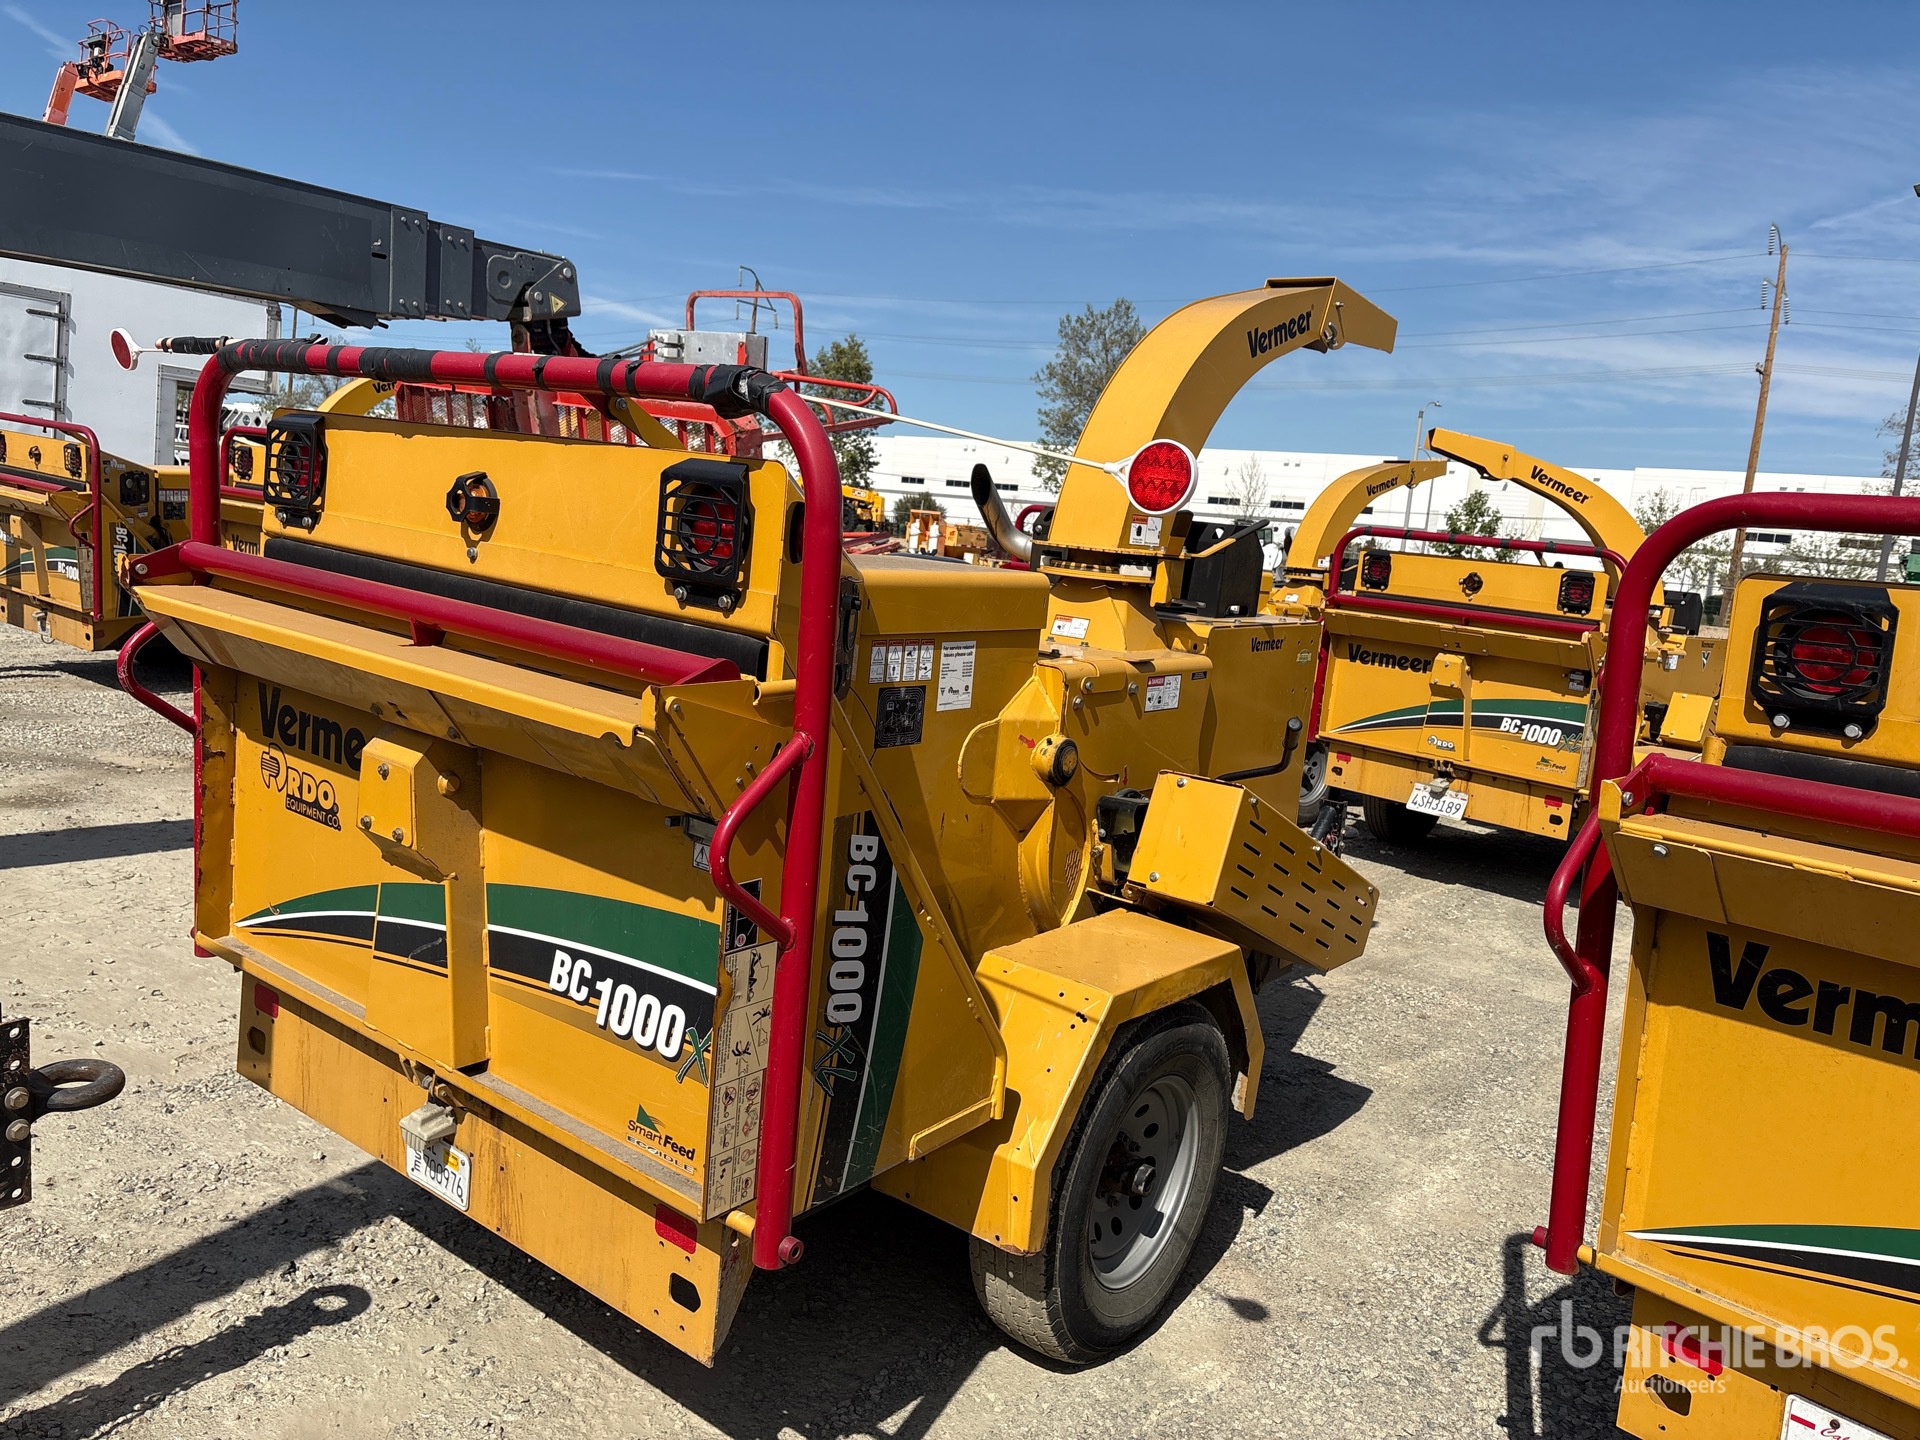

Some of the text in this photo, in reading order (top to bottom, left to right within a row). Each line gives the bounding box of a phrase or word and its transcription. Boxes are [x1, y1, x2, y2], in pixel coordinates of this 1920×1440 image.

[1247, 309, 1312, 359] Vermeer
[1366, 475, 1400, 497] Vermeer
[1531, 465, 1590, 505] Vermeer
[1251, 637, 1284, 653] Vermeer
[1347, 643, 1432, 674] Vermeer
[1437, 740, 1455, 749] RDO
[286, 767, 337, 811] RDO
[1411, 794, 1463, 816] 4SH3189
[286, 796, 342, 830] EQUIPMENT CO.
[1706, 930, 1920, 1062] Verm
[423, 1153, 464, 1199] 700976
